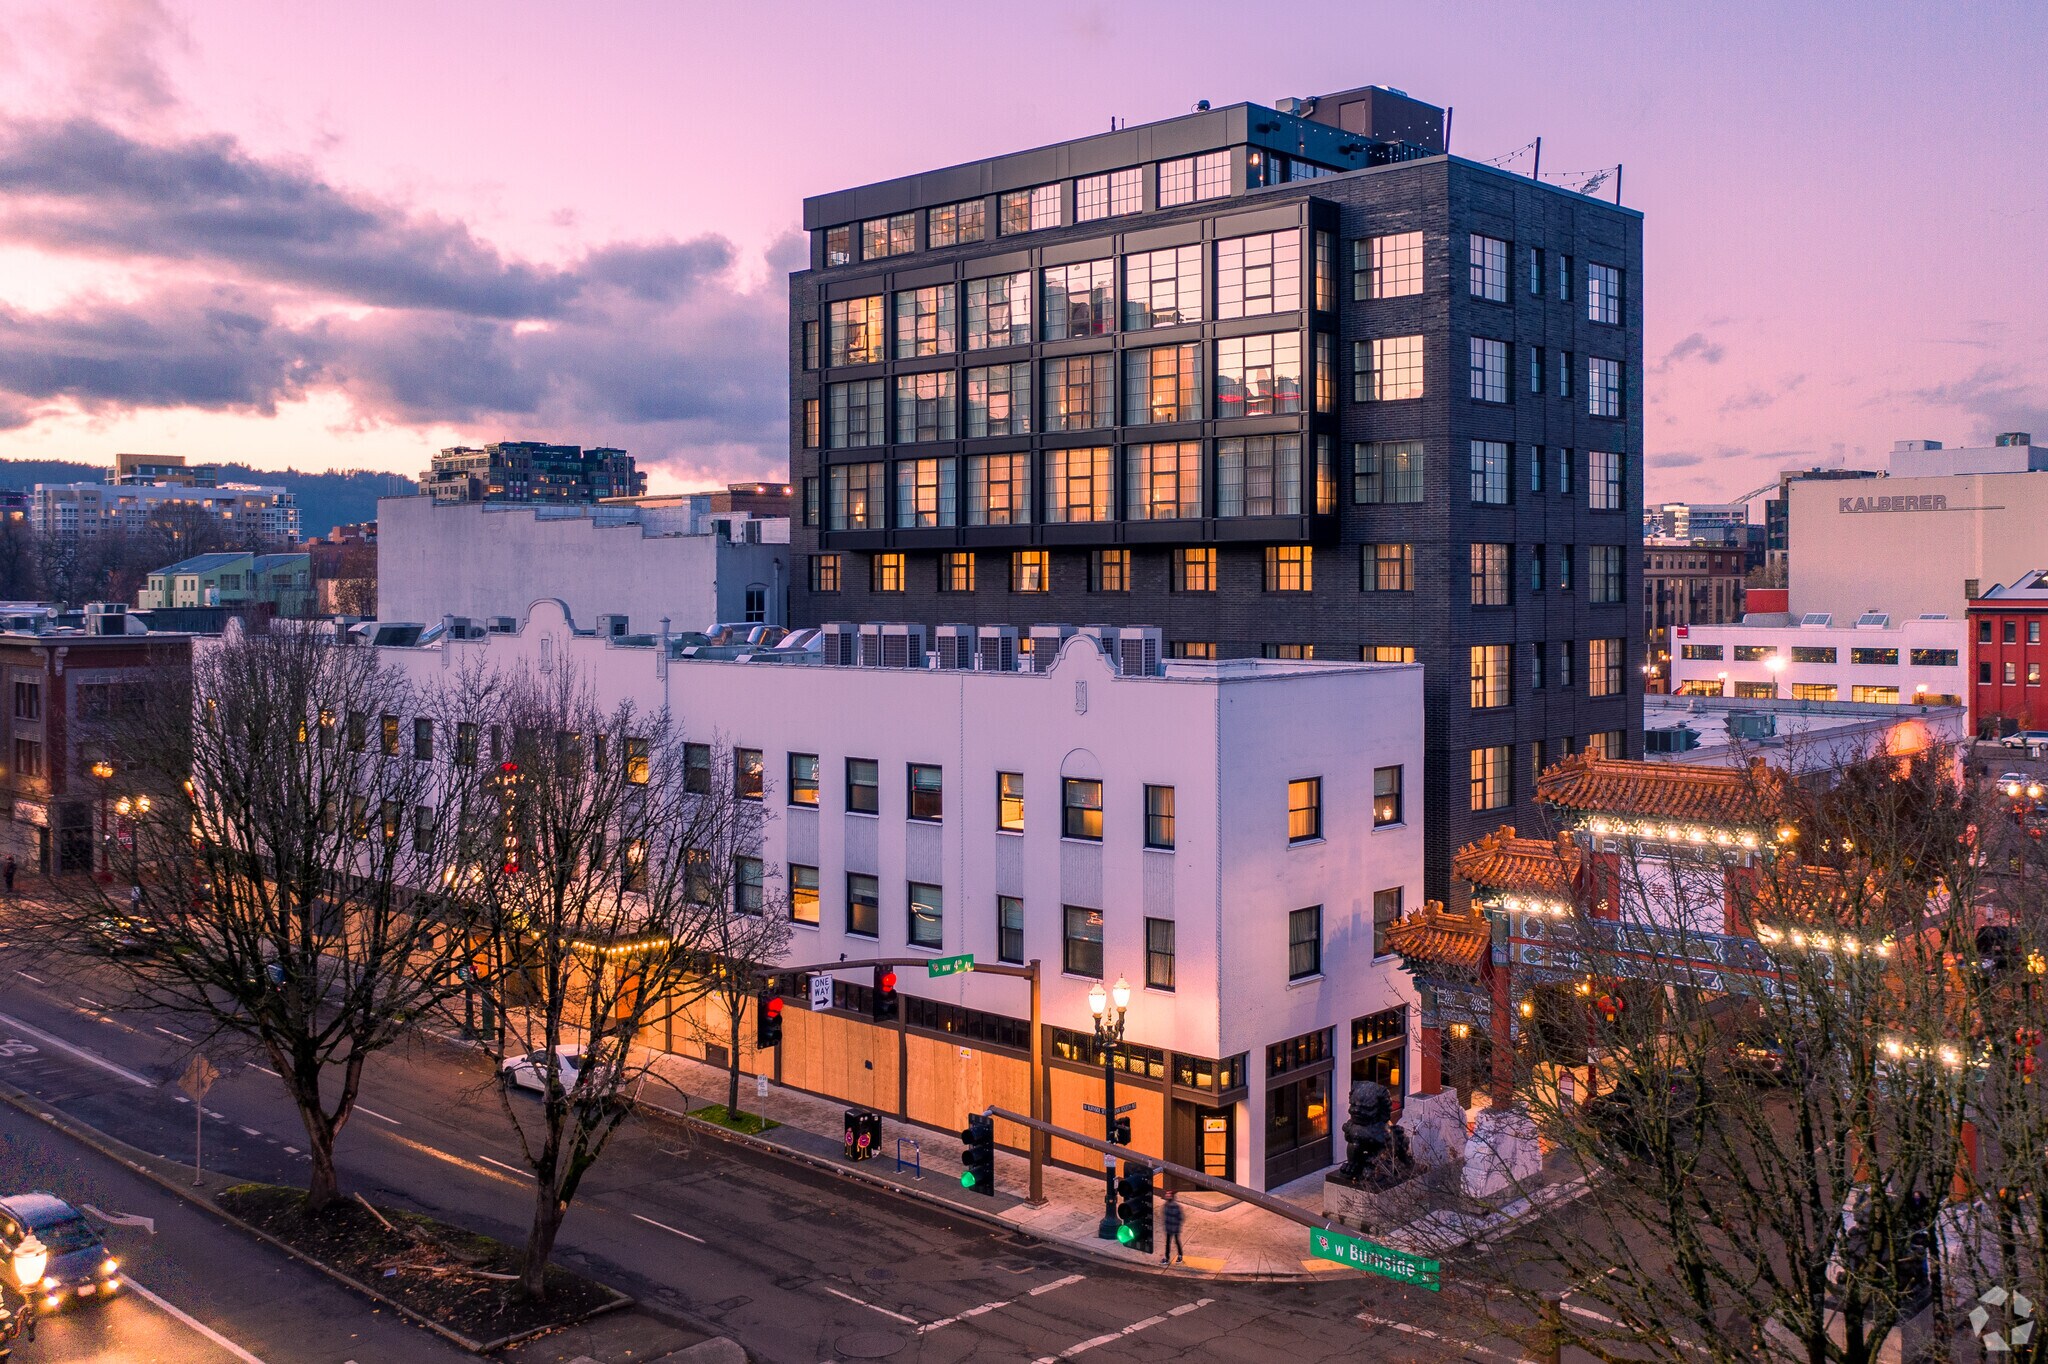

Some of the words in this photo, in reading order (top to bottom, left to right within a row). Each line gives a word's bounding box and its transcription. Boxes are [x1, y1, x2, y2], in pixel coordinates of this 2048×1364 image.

[1839, 494, 1947, 512] KALBERER
[942, 964, 951, 972] NW
[814, 977, 829, 988] ONE
[814, 985, 830, 997] WAY
[1334, 1244, 1344, 1257] W
[1349, 1244, 1416, 1278] Burnside
